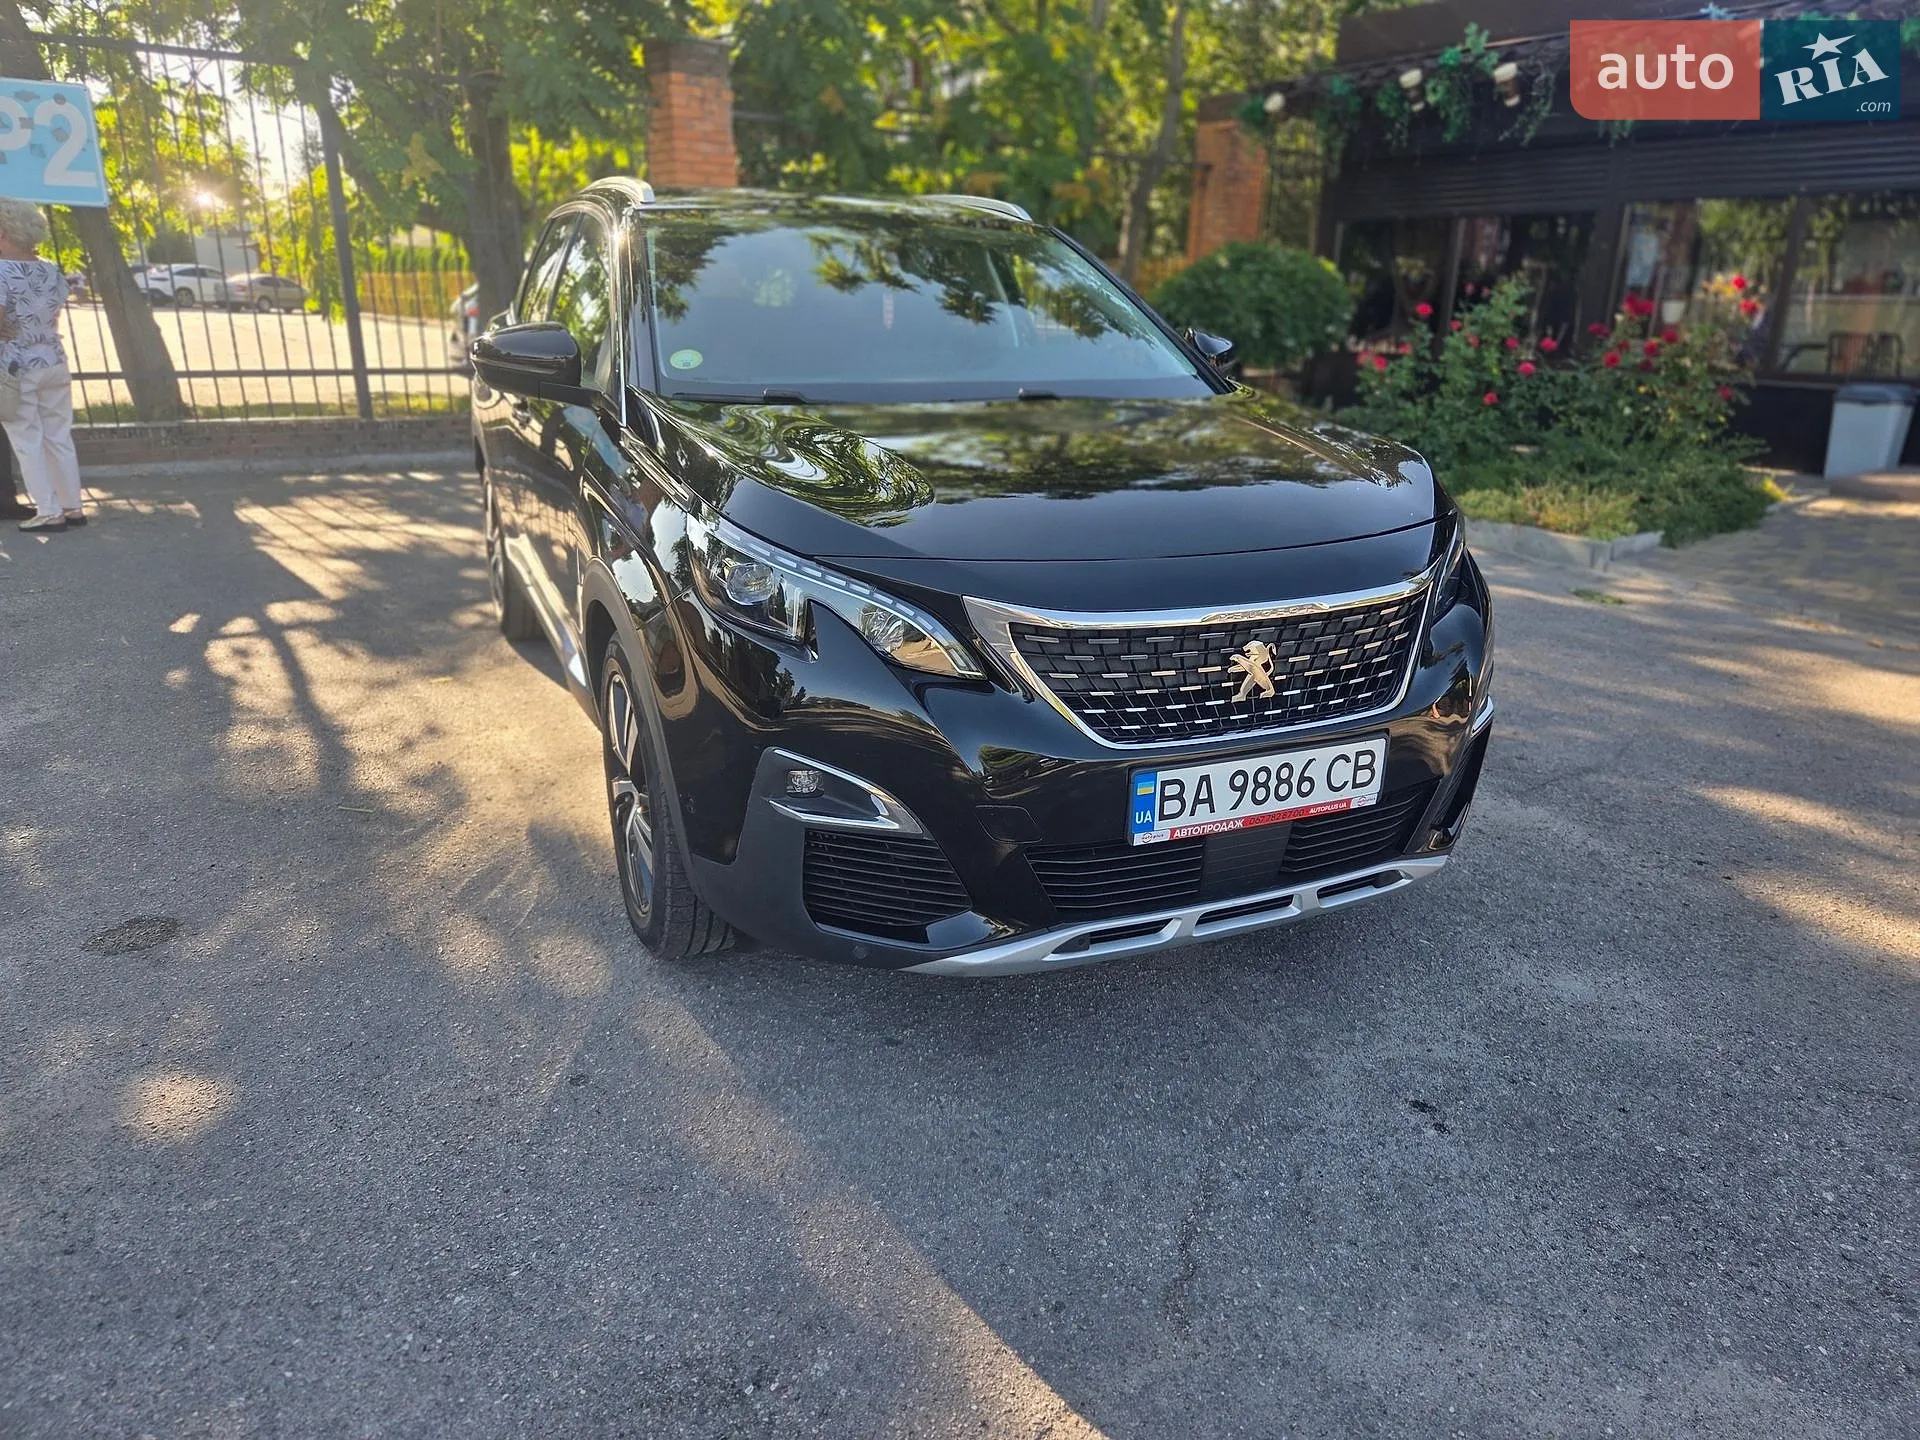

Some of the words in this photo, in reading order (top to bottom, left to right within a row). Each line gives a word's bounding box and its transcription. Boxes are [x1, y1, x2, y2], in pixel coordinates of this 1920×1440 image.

[1158, 774, 1216, 822] BA
[1228, 757, 1317, 811] 9886
[1326, 750, 1377, 793] CB
[1136, 811, 1152, 824] UA
[1173, 819, 1245, 839] АВТОПРОДАЖ
